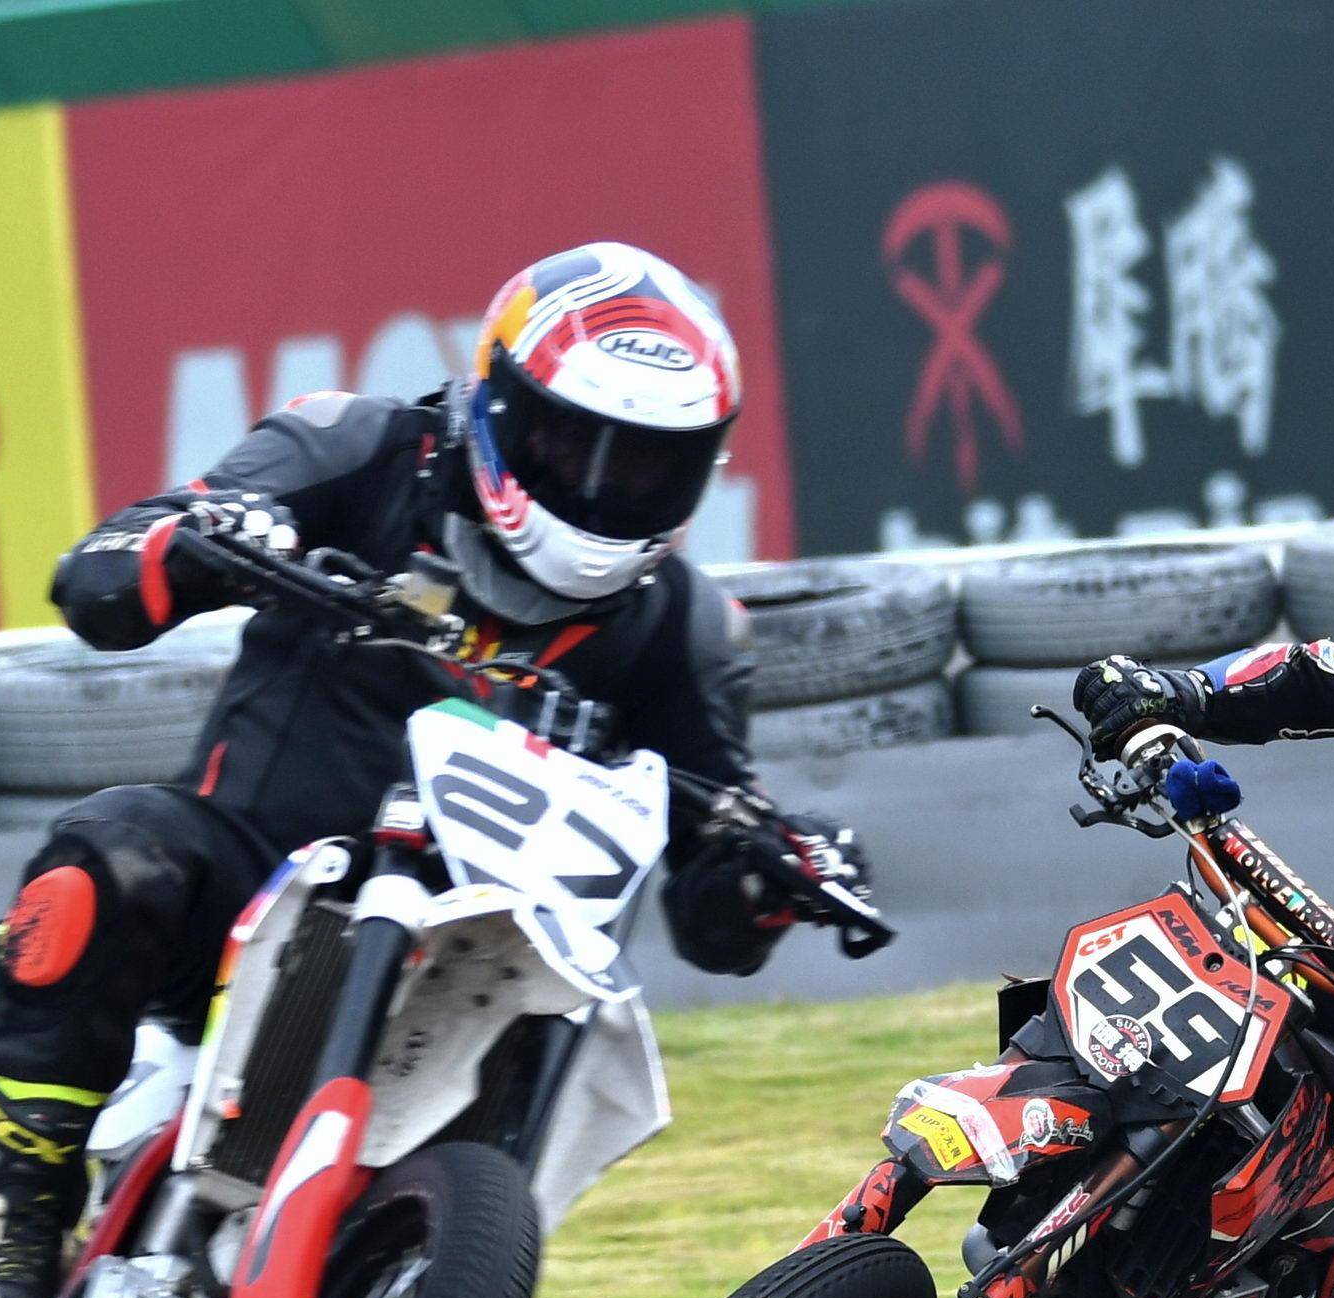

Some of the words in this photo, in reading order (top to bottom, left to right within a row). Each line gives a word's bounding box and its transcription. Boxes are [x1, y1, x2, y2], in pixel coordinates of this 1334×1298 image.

[608, 338, 689, 365] HJC
[431, 751, 639, 900] 27
[1078, 924, 1128, 957] CST
[1156, 910, 1203, 958] KTM
[1073, 934, 1243, 1088] 59
[1115, 1018, 1148, 1050] SUPER
[1090, 1043, 1122, 1073] SPORT
